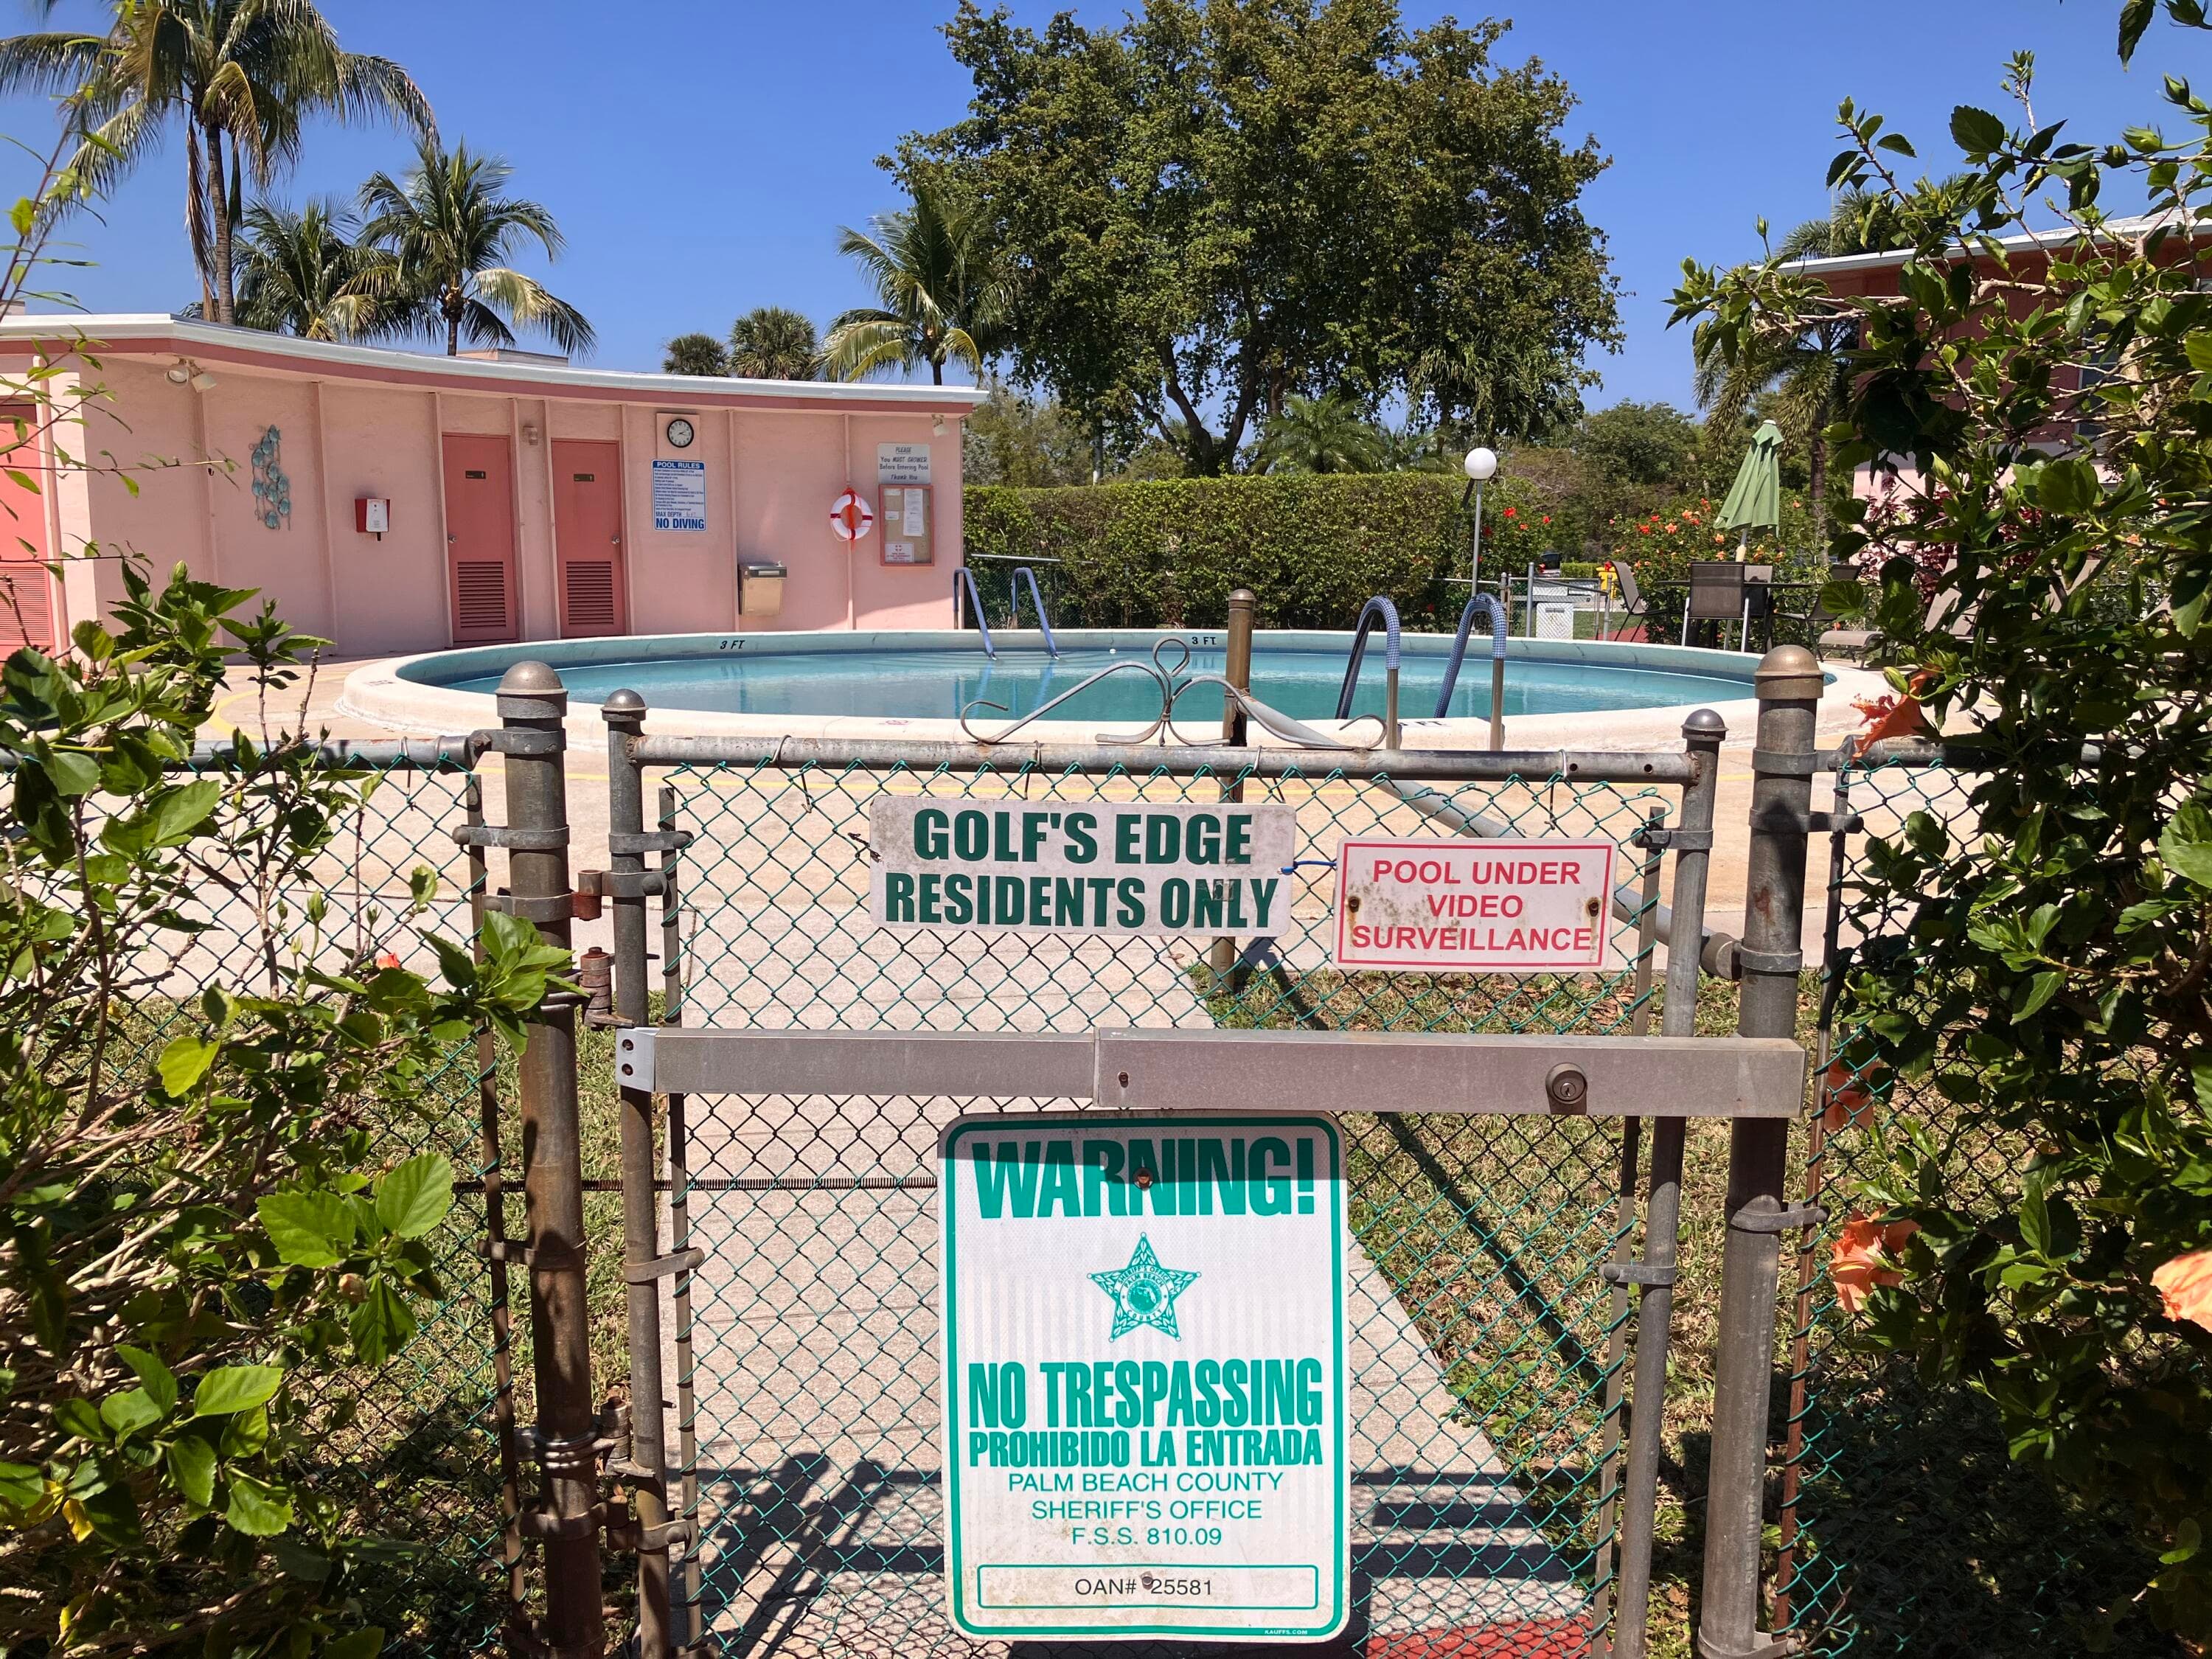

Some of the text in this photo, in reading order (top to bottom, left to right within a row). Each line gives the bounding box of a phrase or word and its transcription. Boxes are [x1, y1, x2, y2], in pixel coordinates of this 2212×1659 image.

[656, 518, 704, 529] NO DIVING
[720, 640, 728, 650] 3
[1192, 636, 1198, 644] 3
[913, 807, 1253, 866] GOLF'S EDGE
[1373, 860, 1581, 886] POOL UNDER
[886, 873, 1279, 929] RESIDENTS ONLY
[1427, 893, 1523, 918] VIDEO
[1352, 924, 1592, 952] SURVEILLANCE
[972, 1136, 1315, 1219] WARNING!
[1119, 1265, 1171, 1284] SHERIFF'S OFFICE
[1124, 1273, 1164, 1287] PALM BEACH
[1127, 1309, 1163, 1321] COUNTY
[969, 1357, 1323, 1429] NO TRESPASSING
[970, 1429, 1323, 1467] PROHIBIDO LA ENTRADA
[1008, 1472, 1284, 1492] PALM BEACH COUNTY
[1032, 1500, 1262, 1519] SHERIFF'S OFFICE
[1072, 1527, 1222, 1545] F.S.S. 810.09
[1074, 1578, 1212, 1596] OAN# 25581
